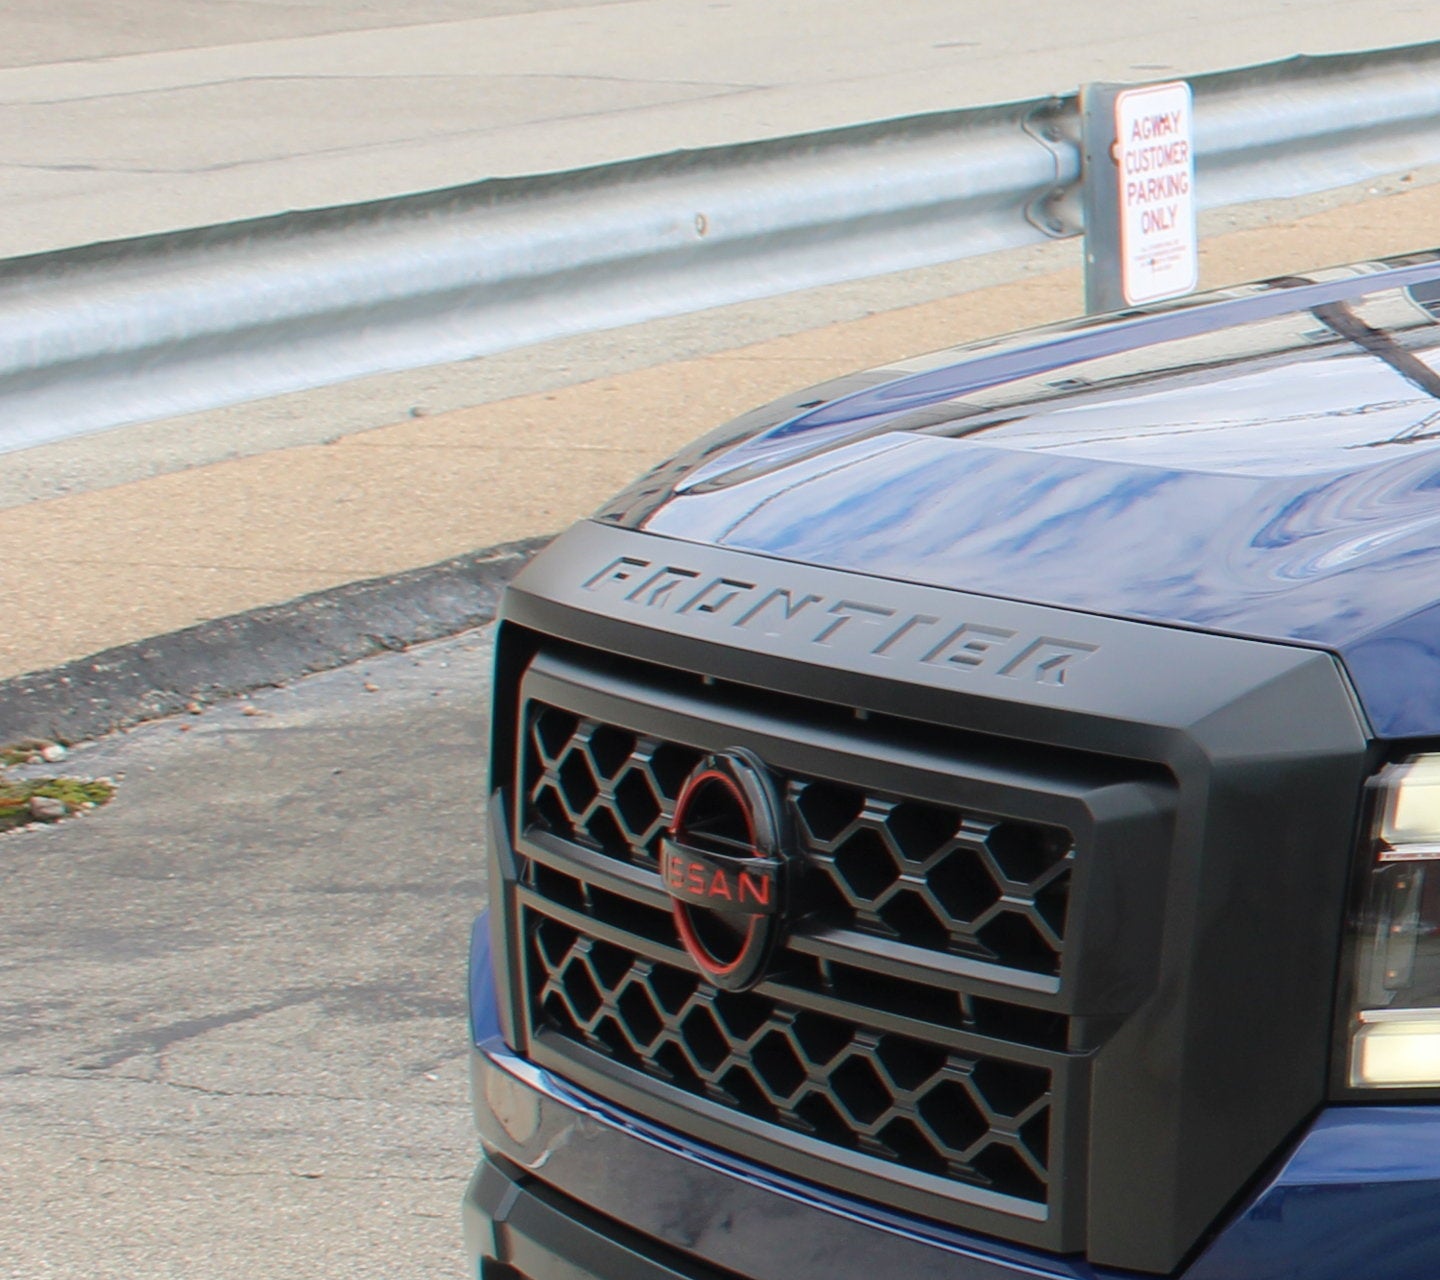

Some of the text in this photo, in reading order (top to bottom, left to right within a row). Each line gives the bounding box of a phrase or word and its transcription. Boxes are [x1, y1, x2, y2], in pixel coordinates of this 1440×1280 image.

[1132, 109, 1181, 142] AGWAY
[1126, 140, 1188, 174] CUSTOMER
[1127, 172, 1188, 206] PARKING
[1141, 204, 1178, 234] ONLY
[584, 556, 1101, 688] FRONTIER
